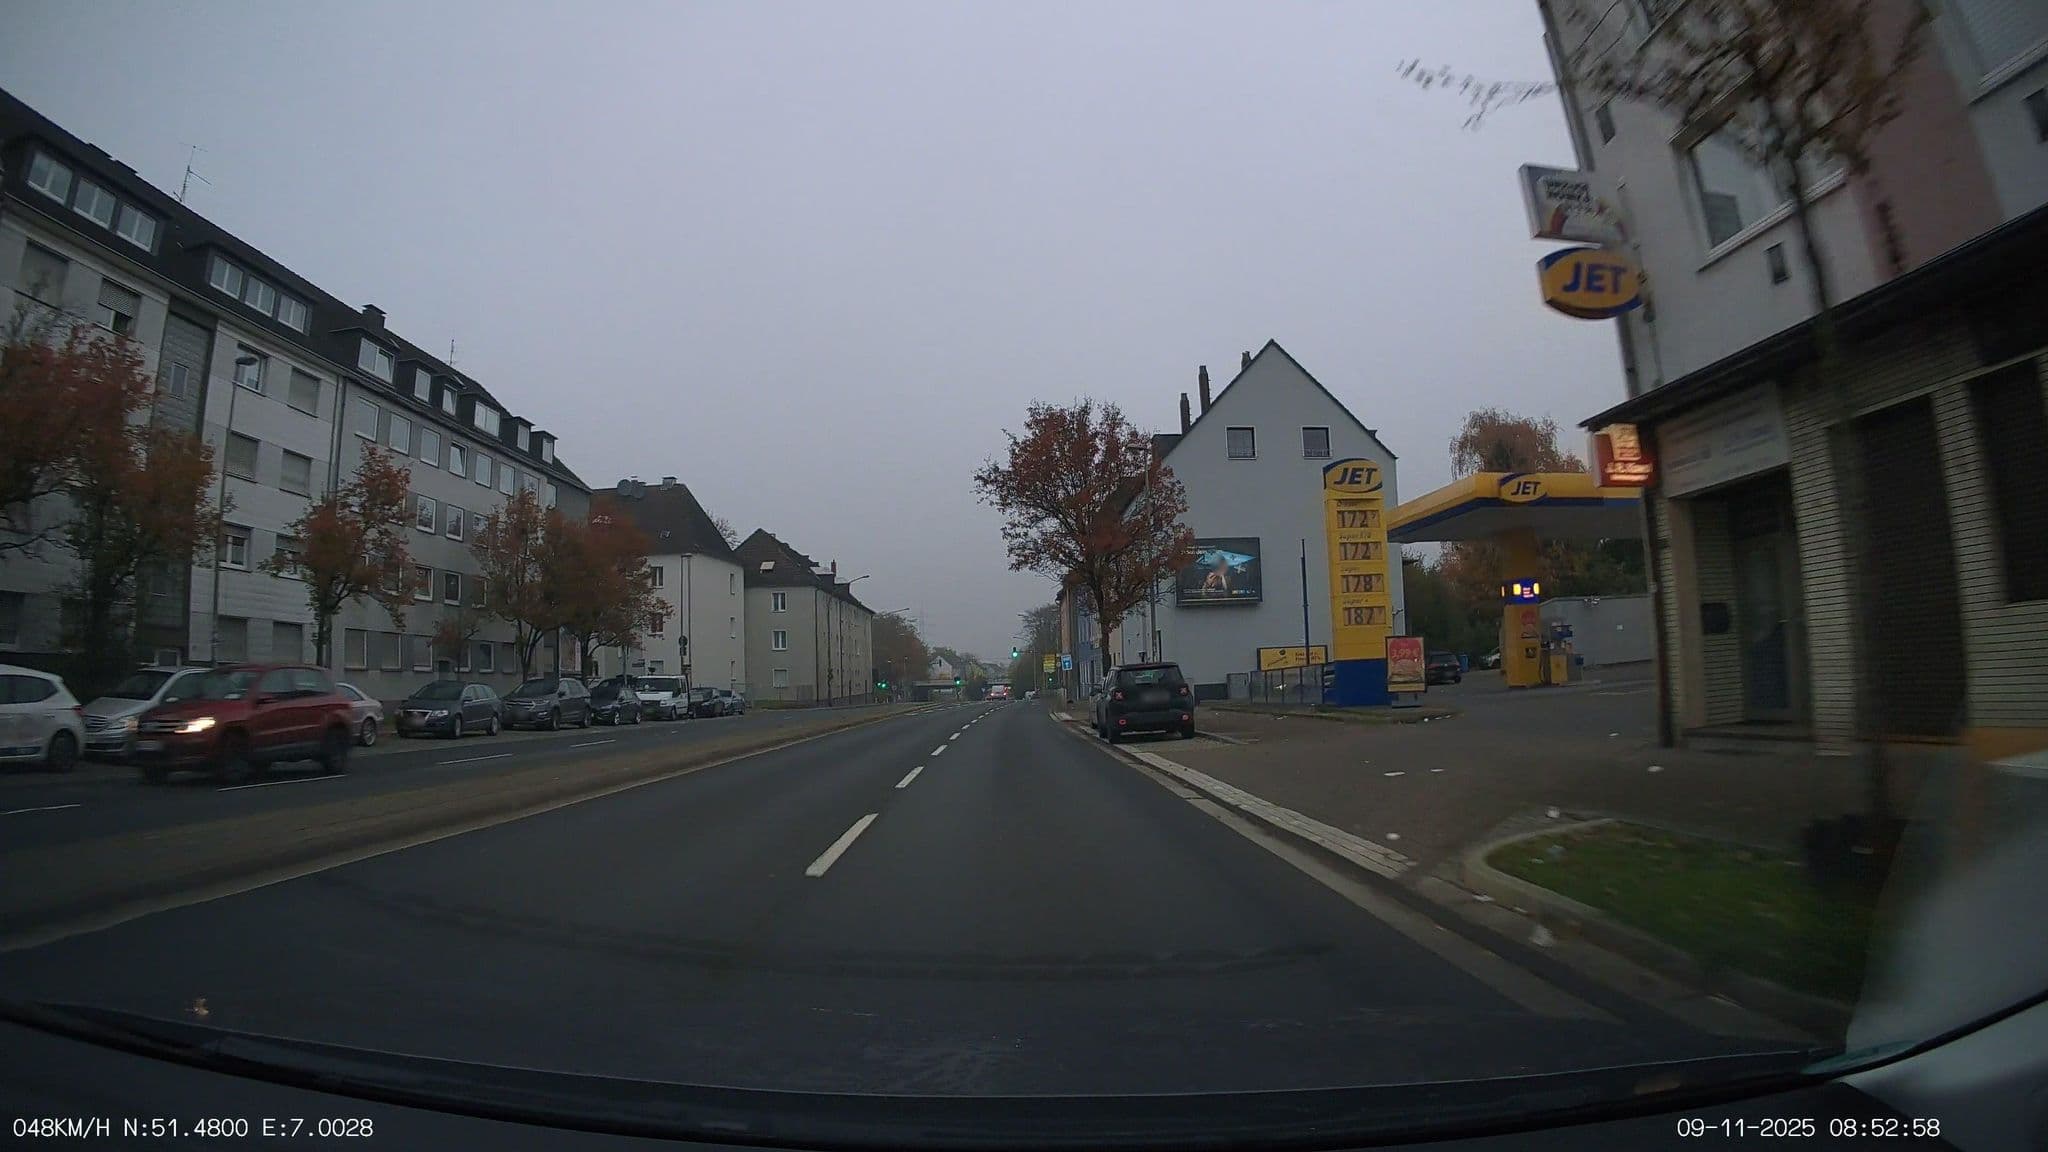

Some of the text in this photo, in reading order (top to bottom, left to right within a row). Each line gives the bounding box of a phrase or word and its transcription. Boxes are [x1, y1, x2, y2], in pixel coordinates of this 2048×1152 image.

[1562, 261, 1628, 294] JET
[1334, 467, 1378, 485] JET
[1510, 480, 1542, 496] JET
